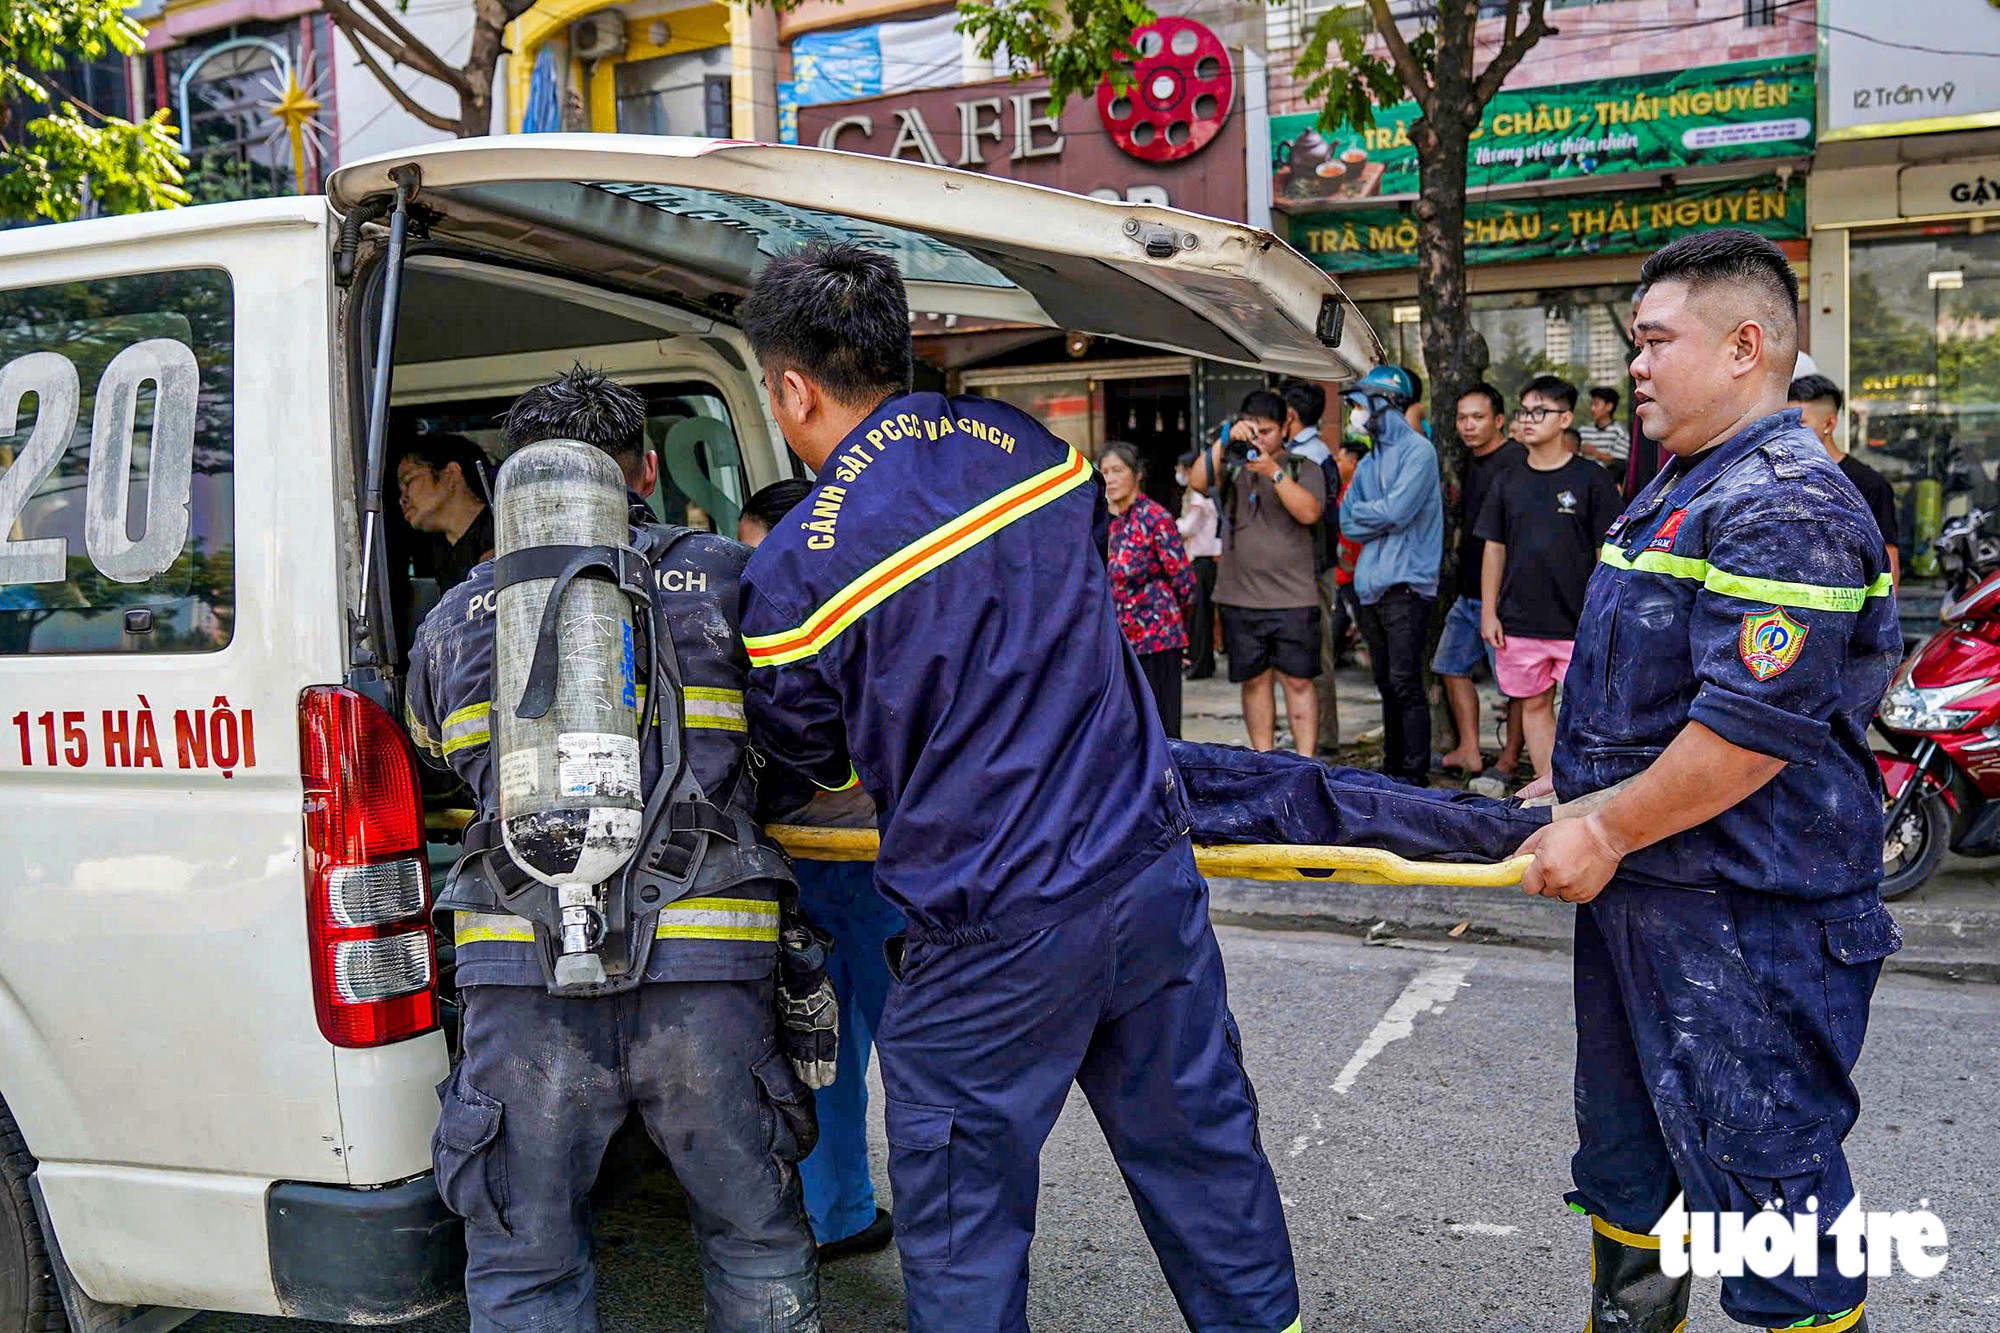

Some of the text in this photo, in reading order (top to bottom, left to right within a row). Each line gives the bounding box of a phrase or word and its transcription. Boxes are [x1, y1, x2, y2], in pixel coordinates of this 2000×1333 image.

[1493, 103, 1573, 137] CHÂU
[1595, 92, 1660, 126] THÁI
[1668, 79, 1789, 117] NGUYÊN
[1306, 222, 1361, 253] TRÀ
[1368, 218, 1419, 254] MỘ
[1568, 200, 1640, 236] THÁI
[1651, 187, 1787, 230] NGUYÊN
[800, 485, 847, 550] CẢNH
[835, 443, 875, 483] SÁT
[865, 413, 923, 452] PCCC
[956, 417, 1016, 455] CNCH
[12, 693, 257, 780] 115 HÀ NỘI
